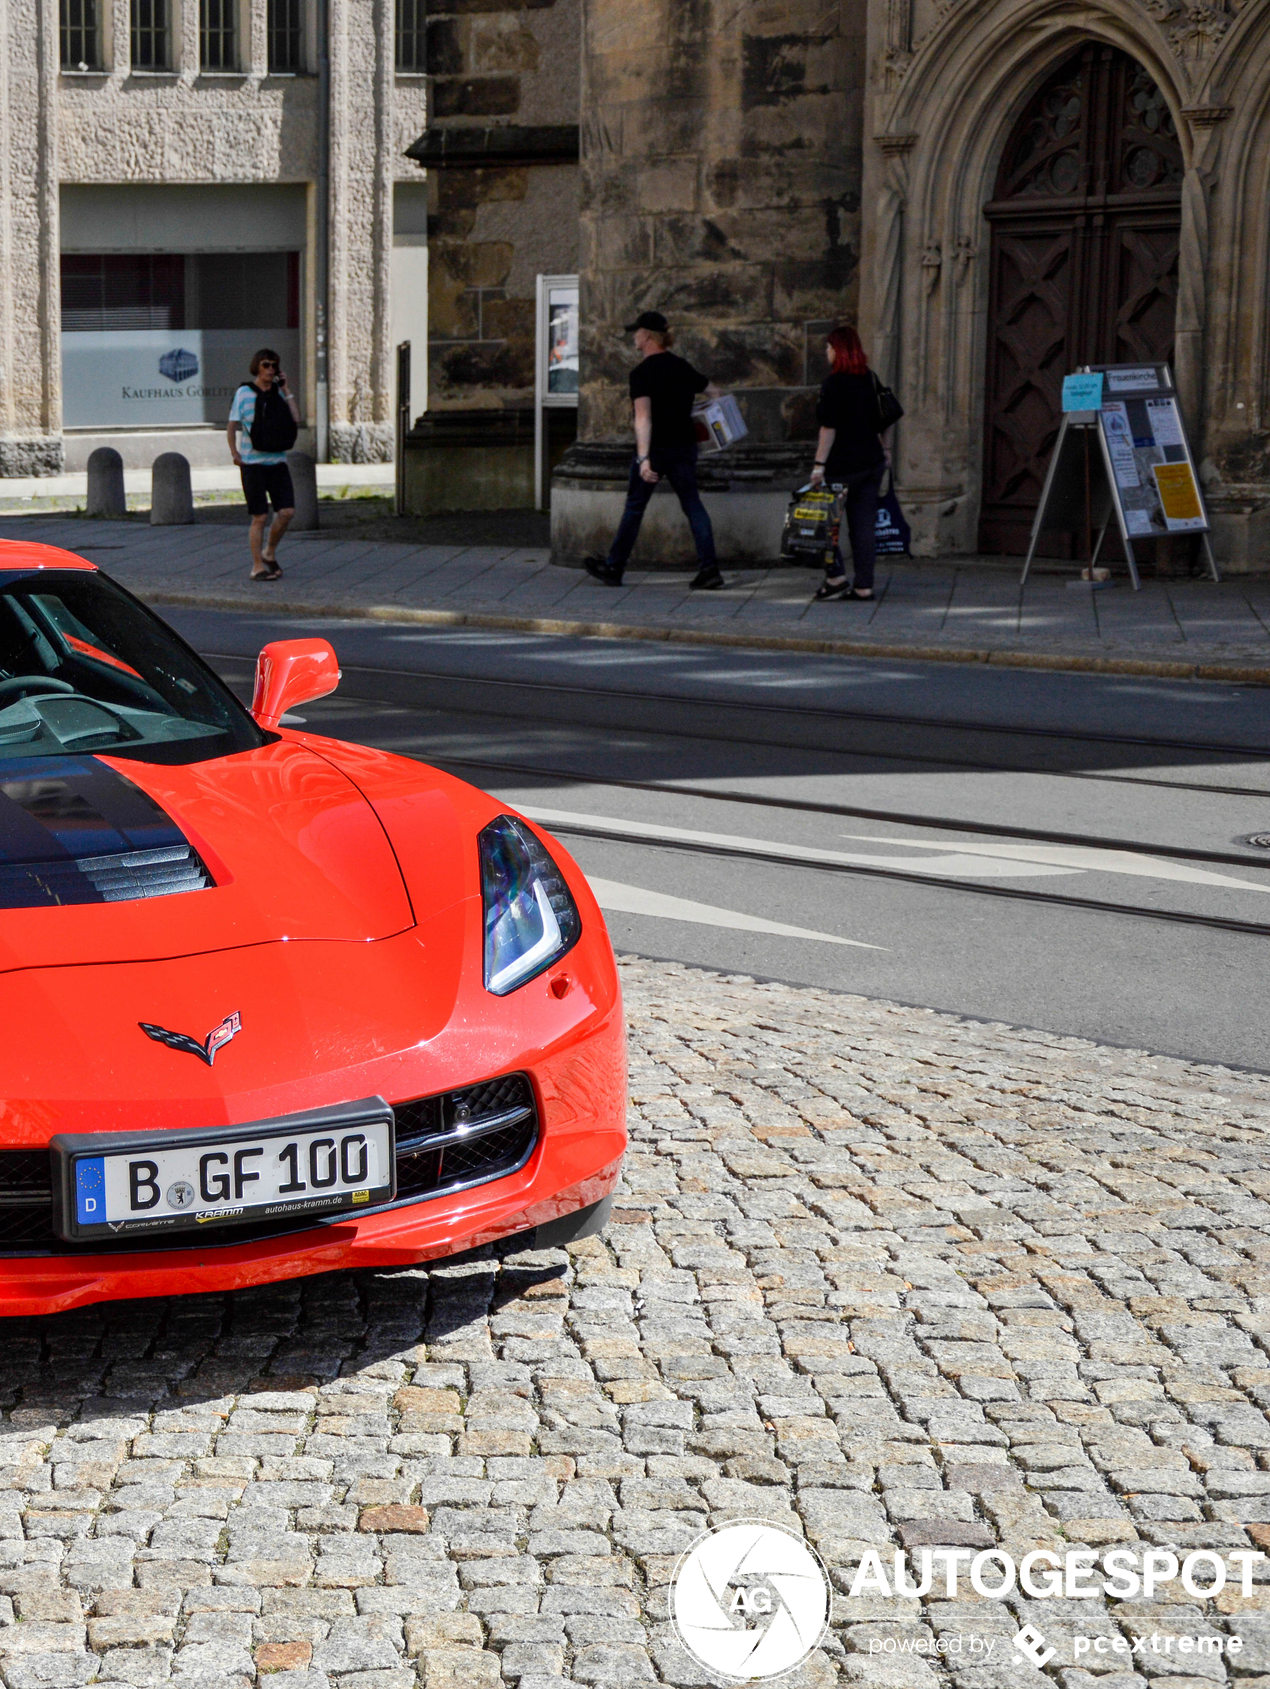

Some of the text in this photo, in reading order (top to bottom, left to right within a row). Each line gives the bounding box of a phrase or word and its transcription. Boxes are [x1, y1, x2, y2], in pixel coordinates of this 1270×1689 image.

[1108, 371, 1157, 382] Frauenkirche
[85, 1198, 97, 1212] D
[130, 1160, 161, 1211] B
[199, 1147, 264, 1202] GF
[278, 1133, 369, 1194] 100
[265, 1196, 343, 1214] autohaus-kramm.de
